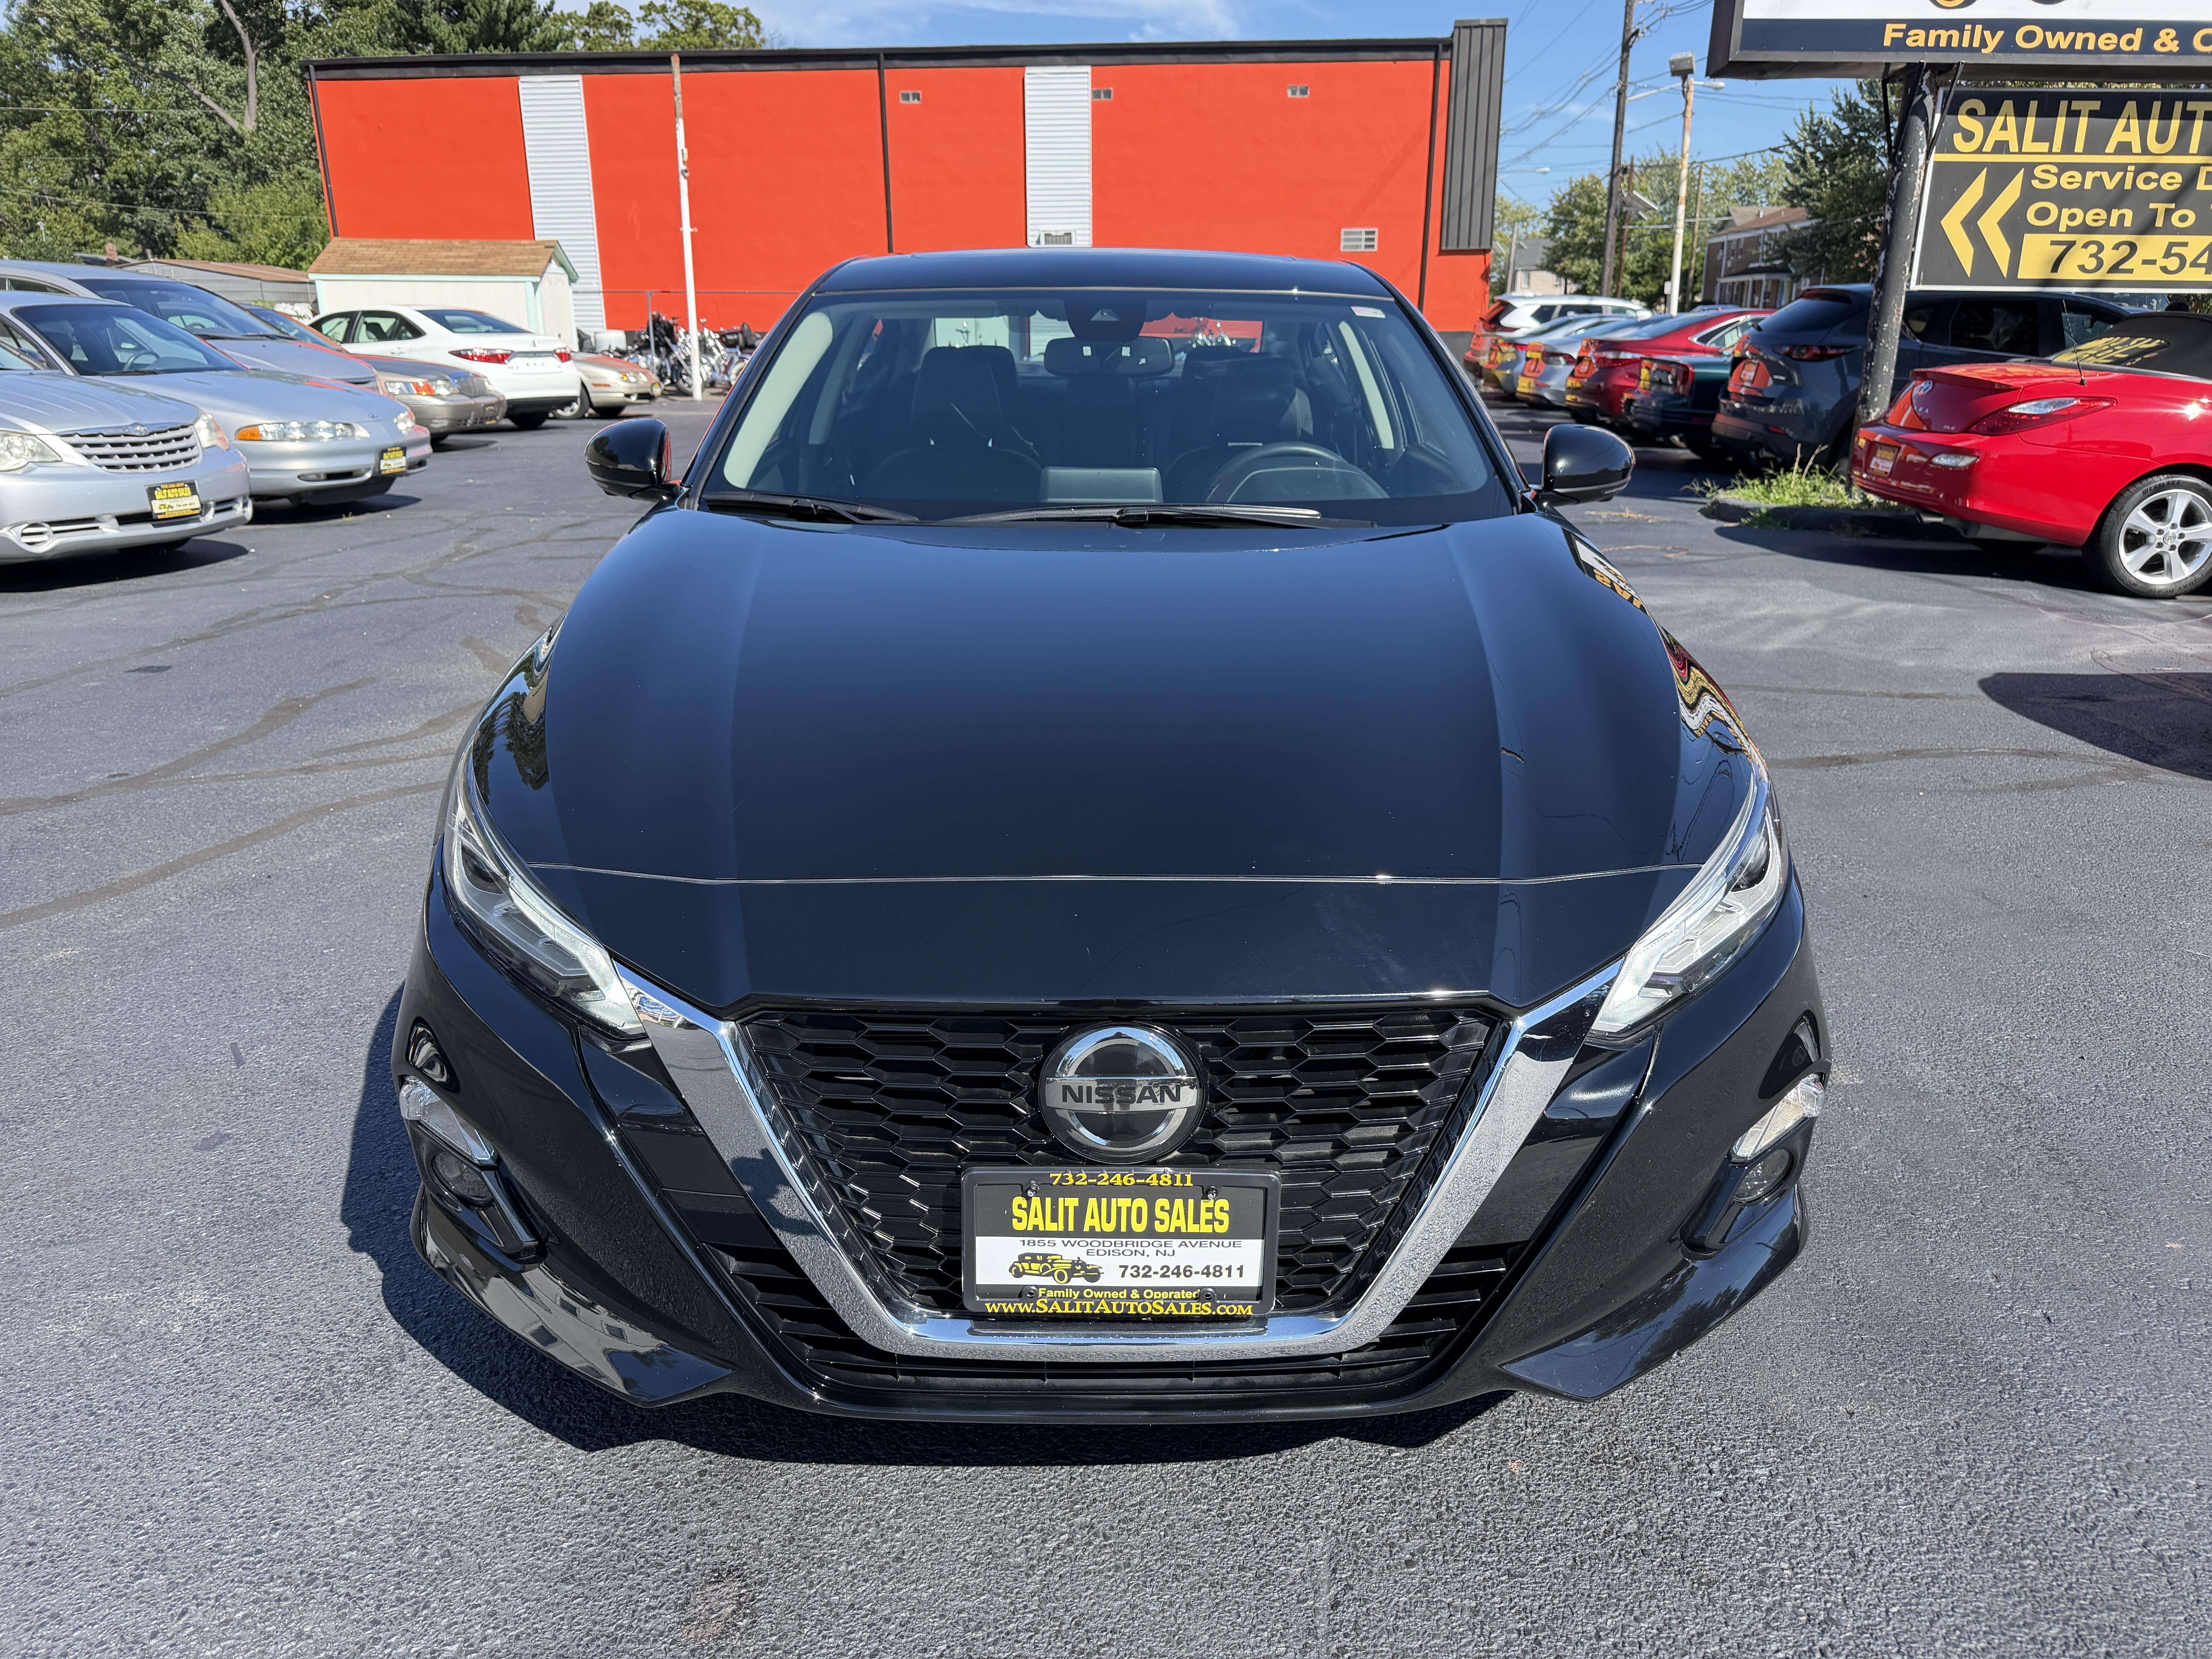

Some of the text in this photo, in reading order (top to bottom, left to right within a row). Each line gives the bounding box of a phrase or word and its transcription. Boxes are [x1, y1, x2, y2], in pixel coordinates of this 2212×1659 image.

[1884, 23, 2004, 53] Family
[2015, 25, 2142, 51] Owned
[2154, 28, 2179, 52] &
[1953, 98, 2101, 153] SALIT
[2031, 164, 2182, 190] Service
[2026, 201, 2196, 232] Open To
[1062, 1084, 1180, 1104] NISSAN
[1049, 1173, 1193, 1187] 732-246-4811
[1012, 1196, 1230, 1233] SALIT AUTO SALES
[1086, 1249, 1149, 1257] EDISON,
[1119, 1264, 1244, 1278] 732-246-4811
[1039, 1288, 1080, 1299] Family
[1084, 1288, 1127, 1298] Owned
[1130, 1289, 1140, 1298] &
